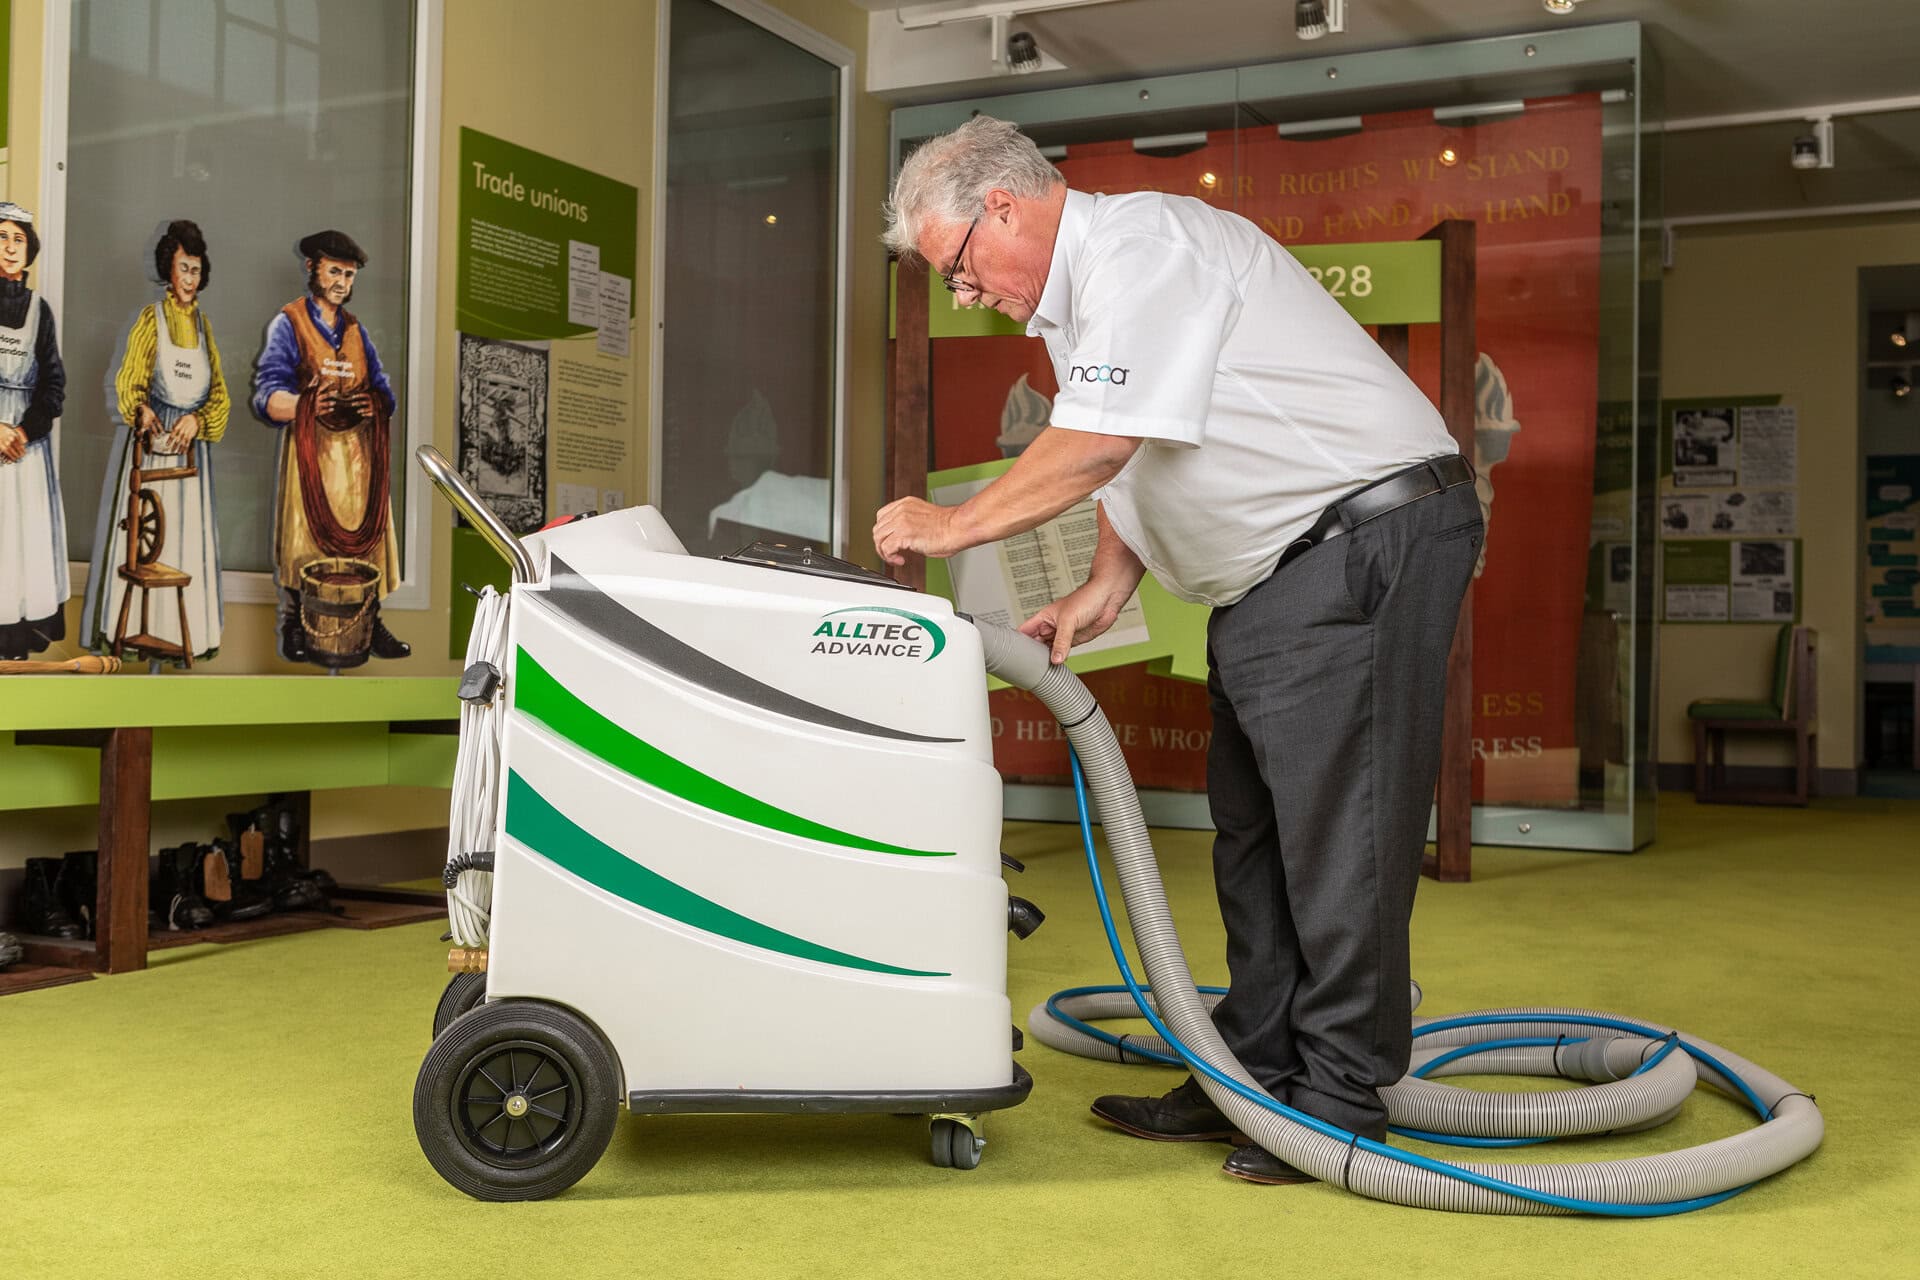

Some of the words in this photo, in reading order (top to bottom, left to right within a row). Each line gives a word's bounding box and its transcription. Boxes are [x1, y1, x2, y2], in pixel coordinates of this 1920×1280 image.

[1279, 162, 1379, 194] RIGHTS
[1466, 147, 1569, 181] STAND
[472, 161, 525, 201] Trade
[530, 188, 588, 222] unions
[1262, 216, 1304, 240] ND
[1324, 204, 1410, 238] HAND
[1485, 193, 1570, 224] HAND
[1069, 364, 1130, 386] ncca
[812, 620, 923, 641] ALLTEC
[810, 641, 923, 658] ADVANCE
[1481, 692, 1545, 718] ESS
[1471, 736, 1543, 760] RESS
